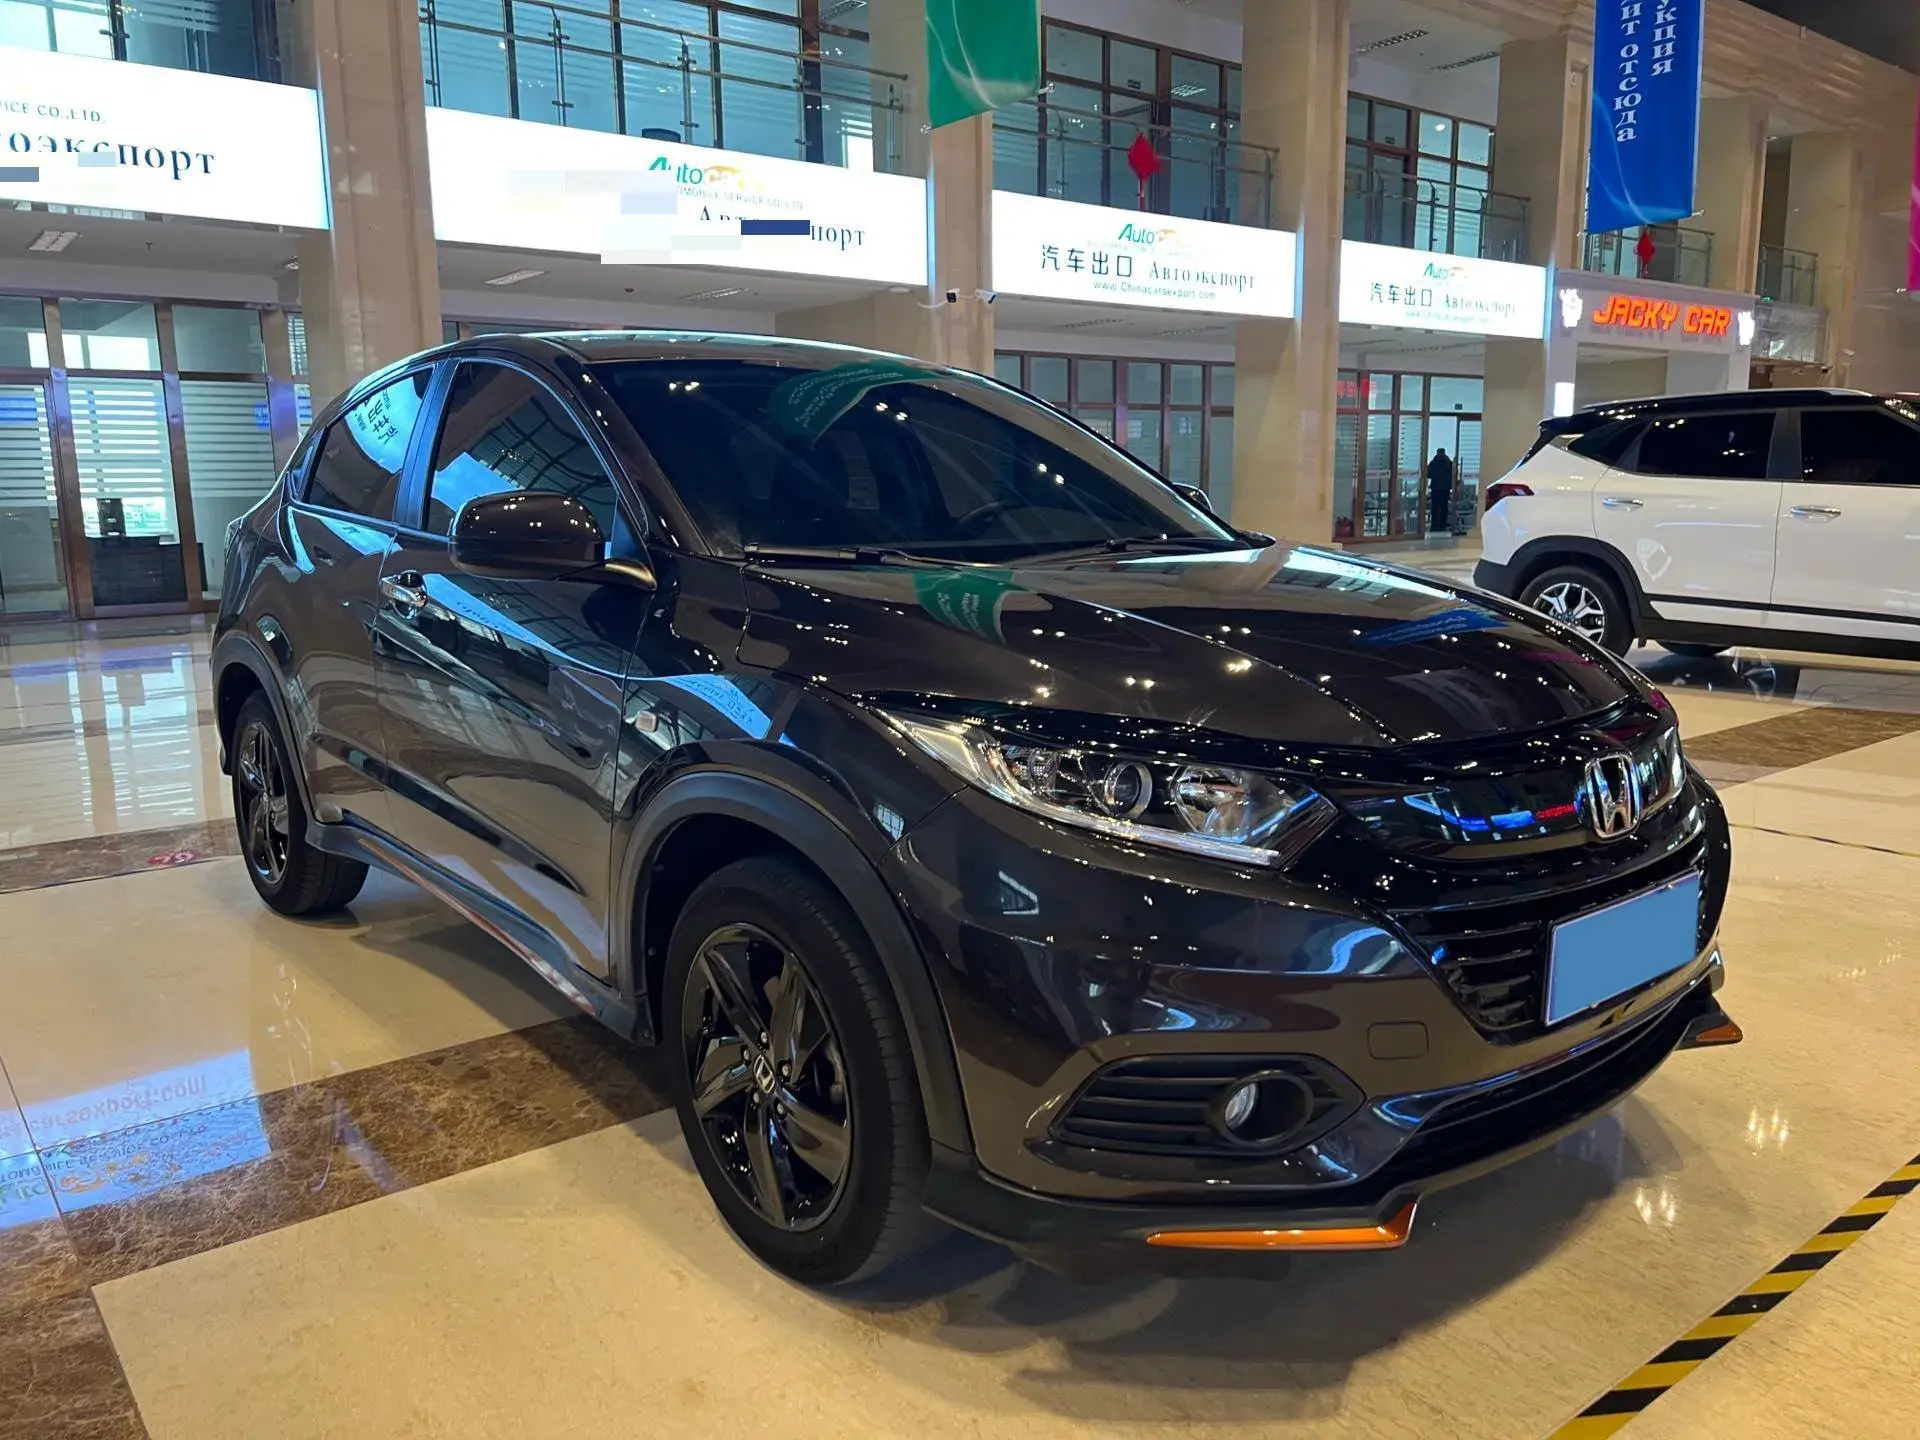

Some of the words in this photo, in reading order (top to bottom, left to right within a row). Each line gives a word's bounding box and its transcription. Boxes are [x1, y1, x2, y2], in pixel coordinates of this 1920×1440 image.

[0, 99, 31, 115] ICE
[1613, 43, 1642, 142] отсюда
[0, 132, 215, 181] оэкспорт
[1117, 223, 1156, 245] Auto
[1041, 245, 1132, 278] 汽车出口
[1370, 282, 1433, 307] 汽车出口
[1592, 294, 1680, 333] JACKY
[1683, 304, 1732, 336] CAR
